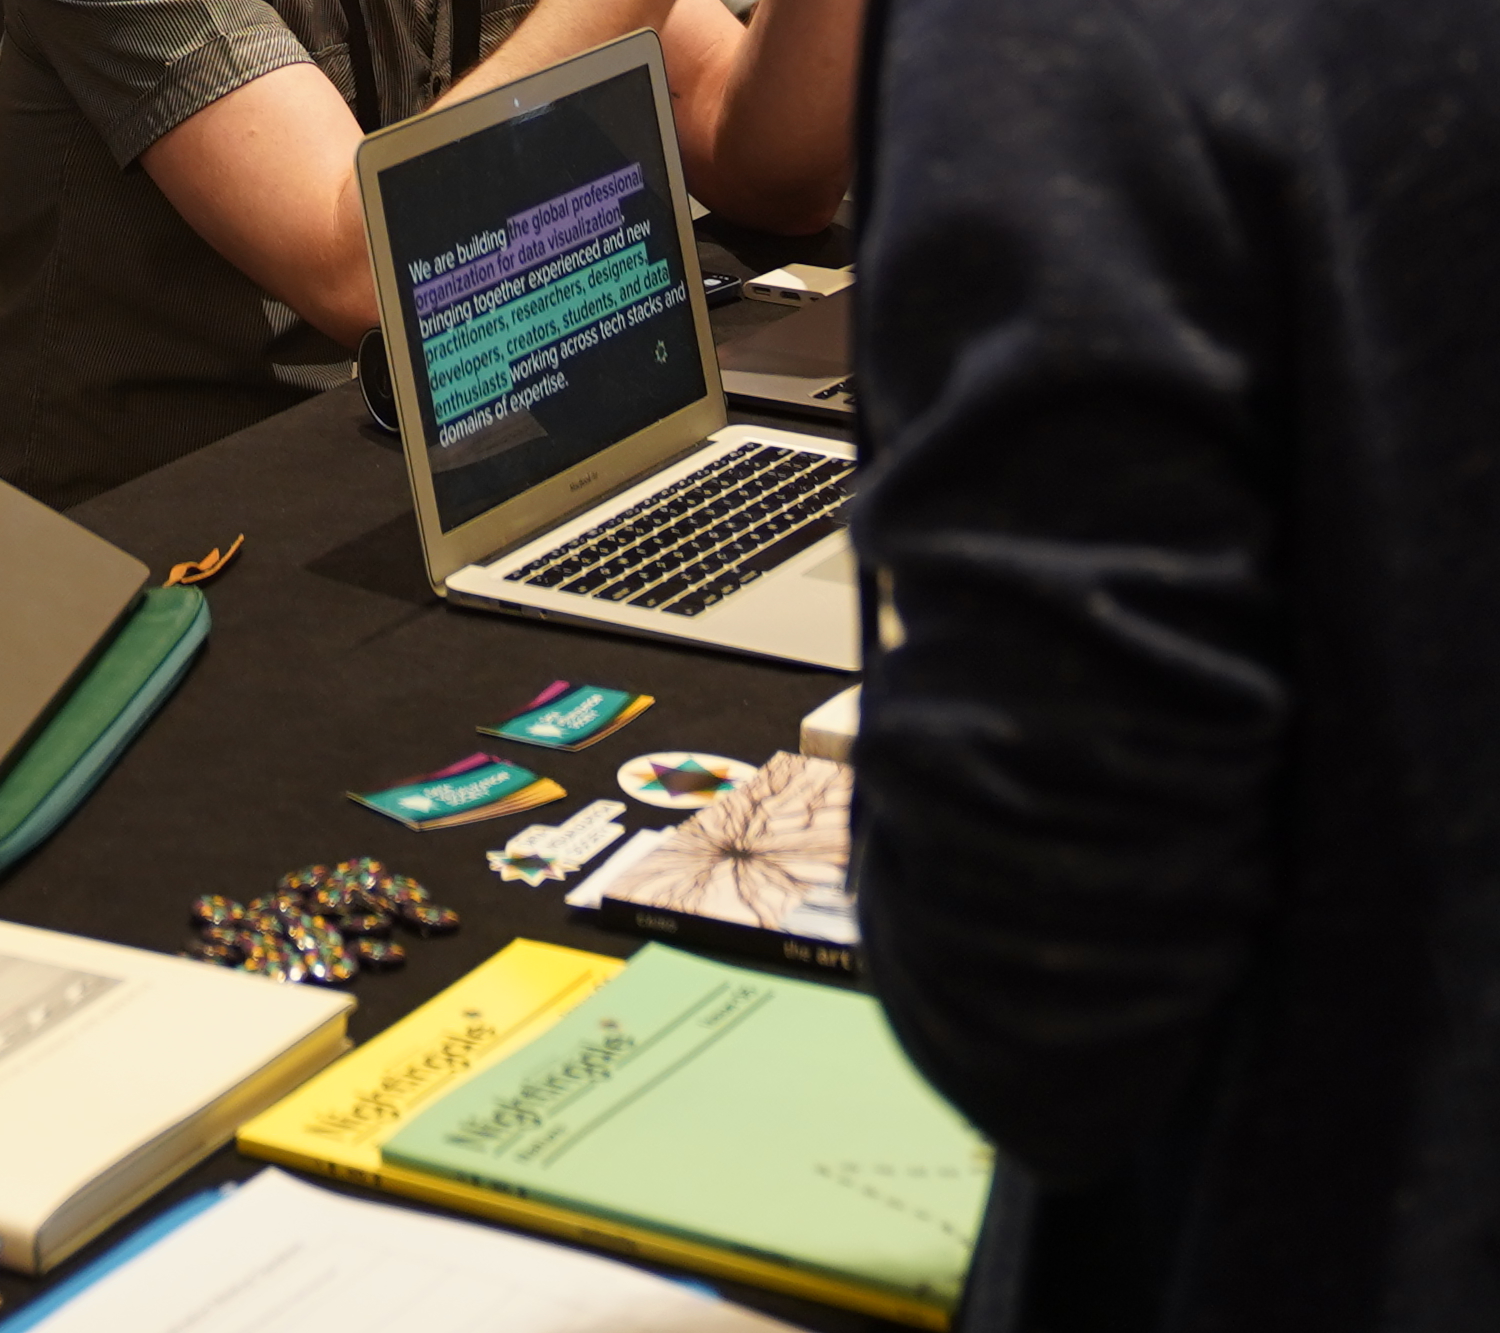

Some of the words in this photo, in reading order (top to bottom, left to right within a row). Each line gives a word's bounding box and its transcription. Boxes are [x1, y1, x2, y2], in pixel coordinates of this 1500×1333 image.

[408, 258, 431, 284] We
[434, 251, 455, 275] are
[456, 228, 507, 264] building
[507, 218, 529, 240] the
[532, 197, 569, 234] global
[571, 165, 643, 218] professional
[415, 262, 496, 310] organization
[497, 253, 515, 275] for
[518, 240, 545, 264] data
[547, 205, 625, 251] visualization,
[419, 301, 472, 339] bringing
[473, 276, 526, 313] together
[528, 238, 601, 289] experienced
[603, 226, 625, 254] and
[626, 218, 650, 244] new
[425, 314, 509, 370] practitioners,
[511, 279, 586, 325] researchers,
[588, 251, 649, 289] designers,
[430, 345, 504, 392] developers,
[507, 319, 560, 356] creators,
[562, 292, 618, 329] students,
[620, 274, 641, 302] and
[643, 264, 669, 290] data
[435, 370, 508, 418] enthusiasts
[509, 347, 559, 383] working
[560, 326, 599, 360] across
[599, 311, 626, 340] tech
[626, 295, 663, 327] stacks
[664, 279, 687, 309] and
[439, 406, 493, 448] domains
[495, 392, 510, 421] of
[510, 371, 569, 413] expertise.
[782, 939, 812, 962] the
[815, 945, 851, 972] art
